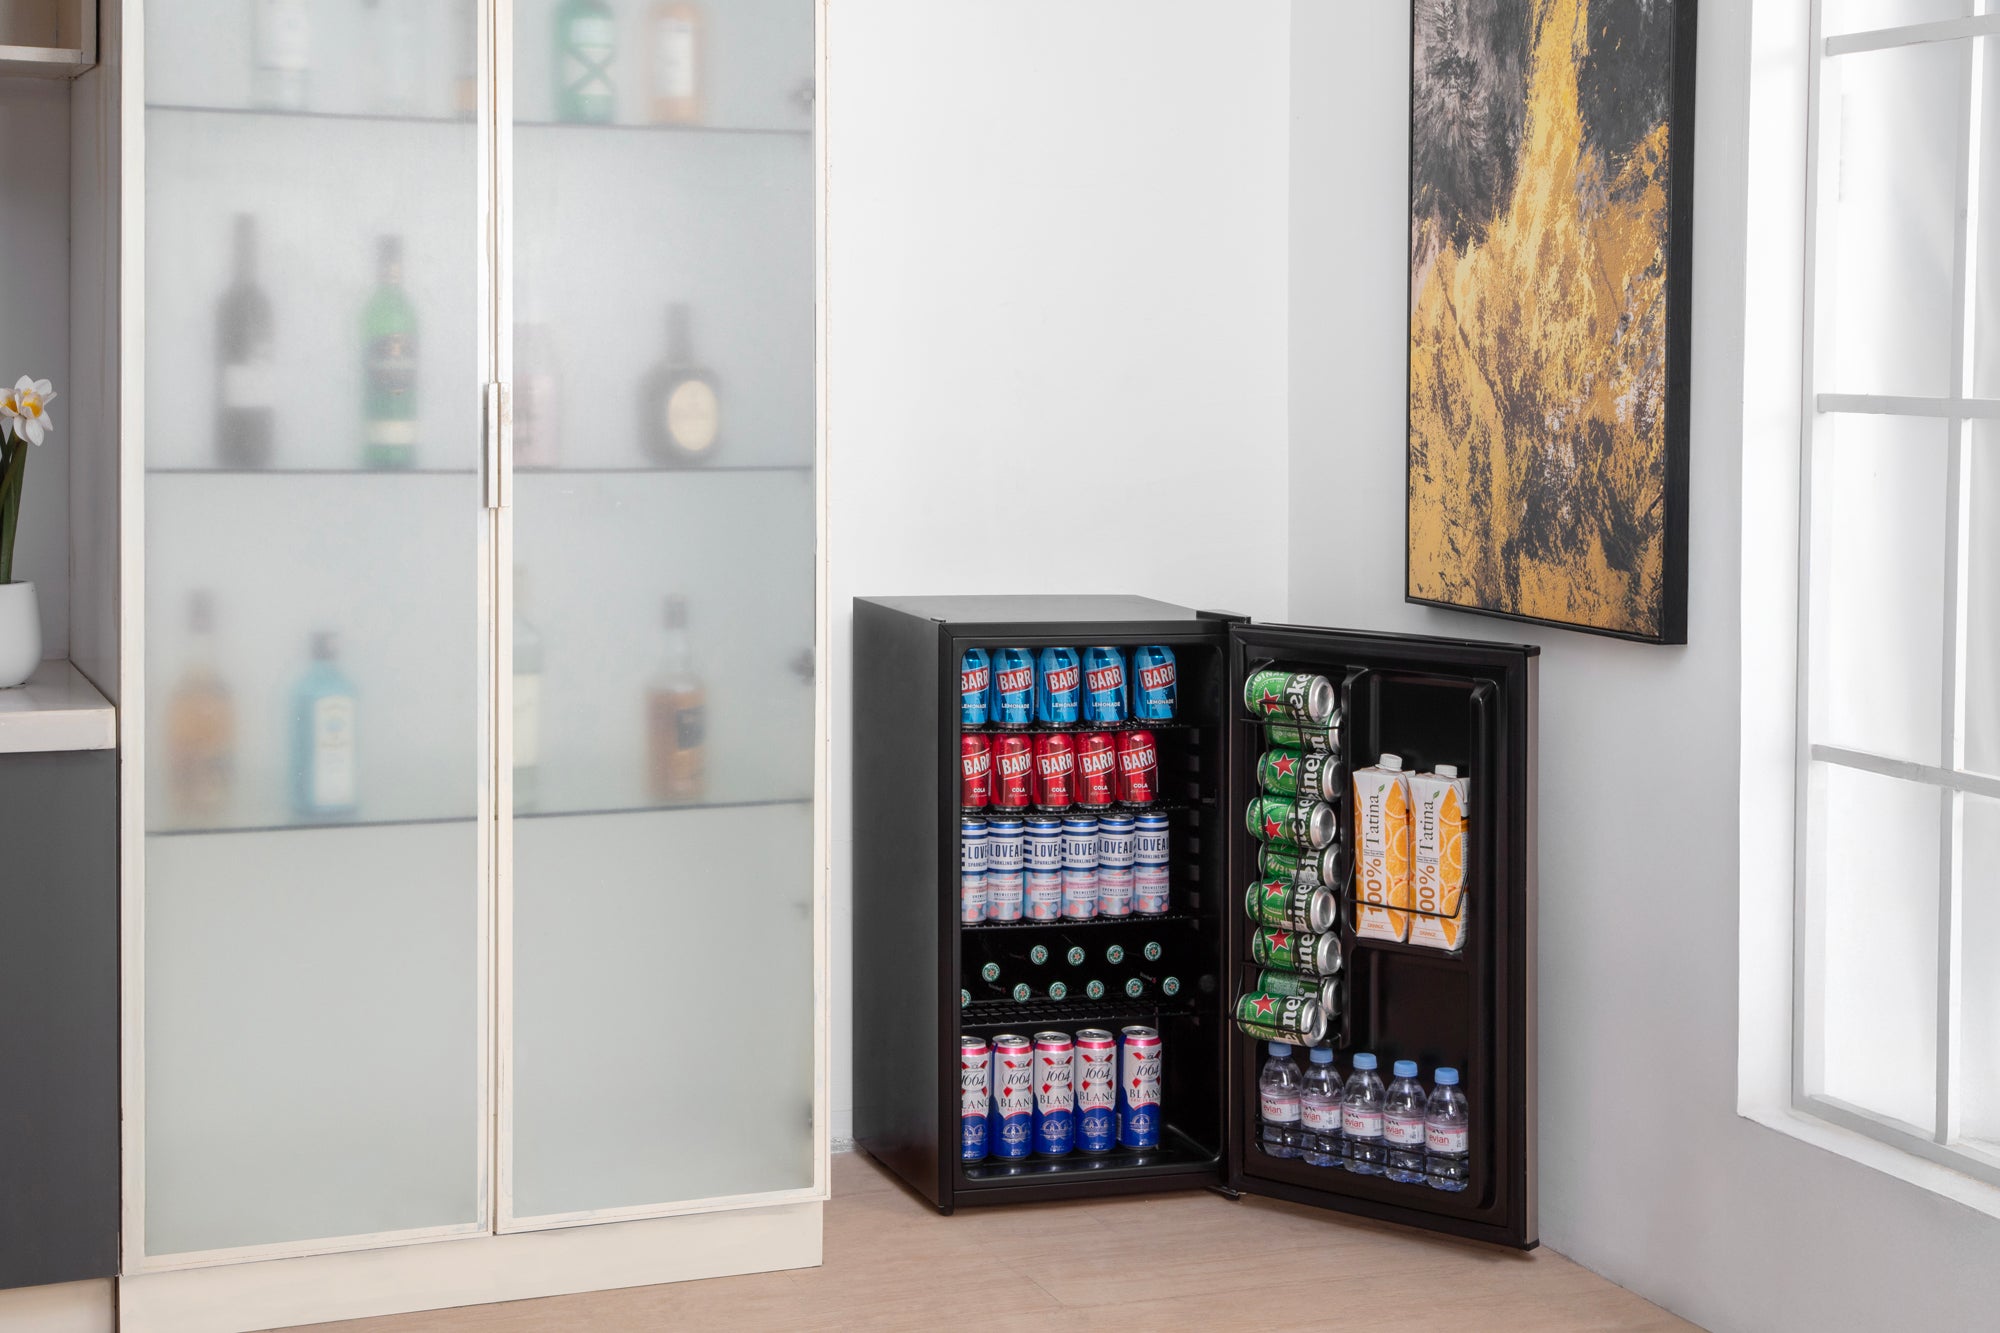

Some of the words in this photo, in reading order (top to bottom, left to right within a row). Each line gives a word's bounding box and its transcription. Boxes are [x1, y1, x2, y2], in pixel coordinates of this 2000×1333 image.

[1000, 670, 1032, 691] BARR
[1049, 668, 1079, 690] BARR
[1089, 668, 1121, 690] BARR
[1143, 665, 1175, 688] BARR
[1002, 753, 1031, 775] BARR
[1041, 753, 1073, 775] BARR
[1083, 751, 1114, 773] BARR
[1122, 749, 1155, 771] BARR
[1366, 795, 1379, 848] Tatina
[1420, 801, 1434, 855] Tatina
[1366, 857, 1382, 915] 100%
[1008, 1072, 1031, 1085] 1664
[1046, 1070, 1070, 1082] 1664
[1085, 1067, 1112, 1080] 1664
[1136, 1064, 1160, 1077] 1664
[1264, 1104, 1282, 1114] evian
[1304, 1110, 1321, 1121] evian
[1344, 1118, 1364, 1129] evian
[1386, 1126, 1405, 1136] evian
[1428, 1134, 1450, 1145] evian
